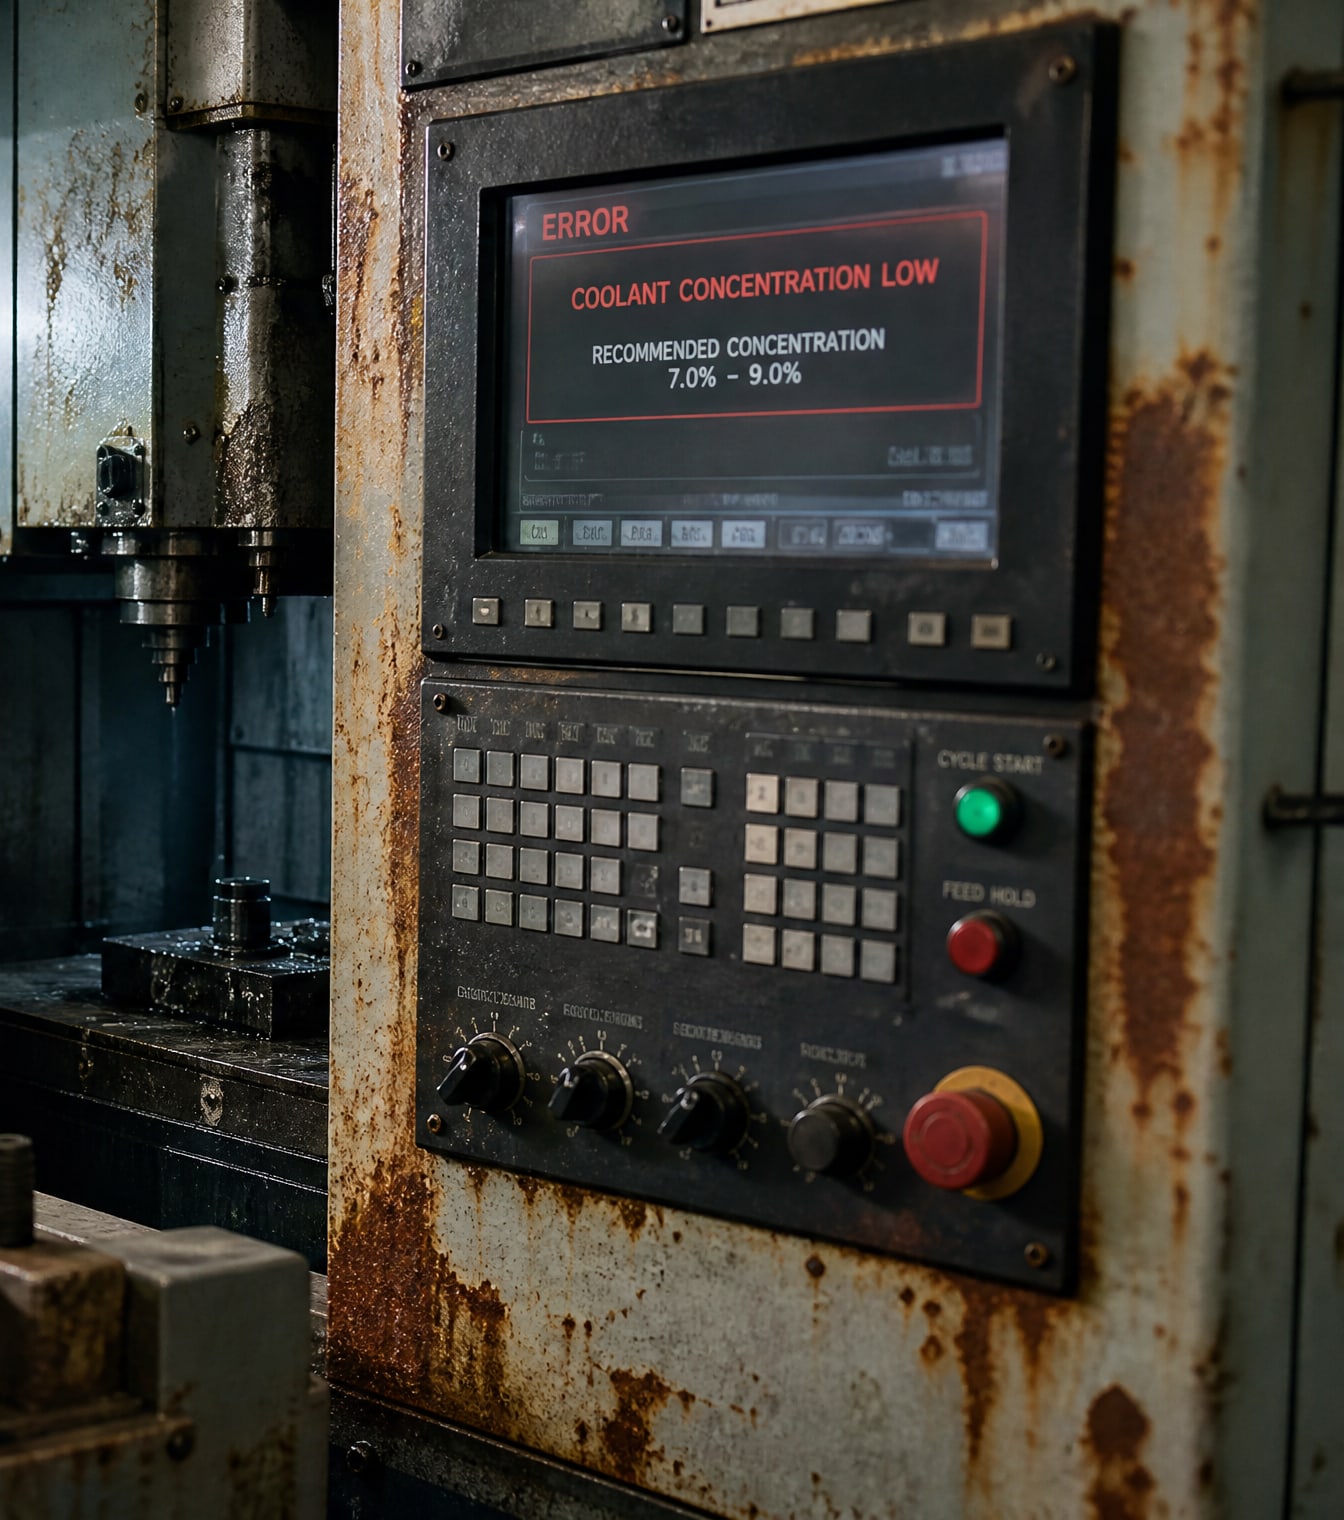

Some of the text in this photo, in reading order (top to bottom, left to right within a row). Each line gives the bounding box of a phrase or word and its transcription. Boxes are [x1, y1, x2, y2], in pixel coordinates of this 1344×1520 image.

[542, 205, 629, 241] ERROR
[571, 257, 940, 310] COOLANT CONCENTRATION LOW
[592, 327, 885, 365] RECOMMENDED CONCENTRATION
[668, 365, 717, 389] 7.0%
[748, 360, 802, 386] 9.0%
[937, 749, 1044, 775] CYCLE START
[942, 880, 1036, 908] FEED HOLD
